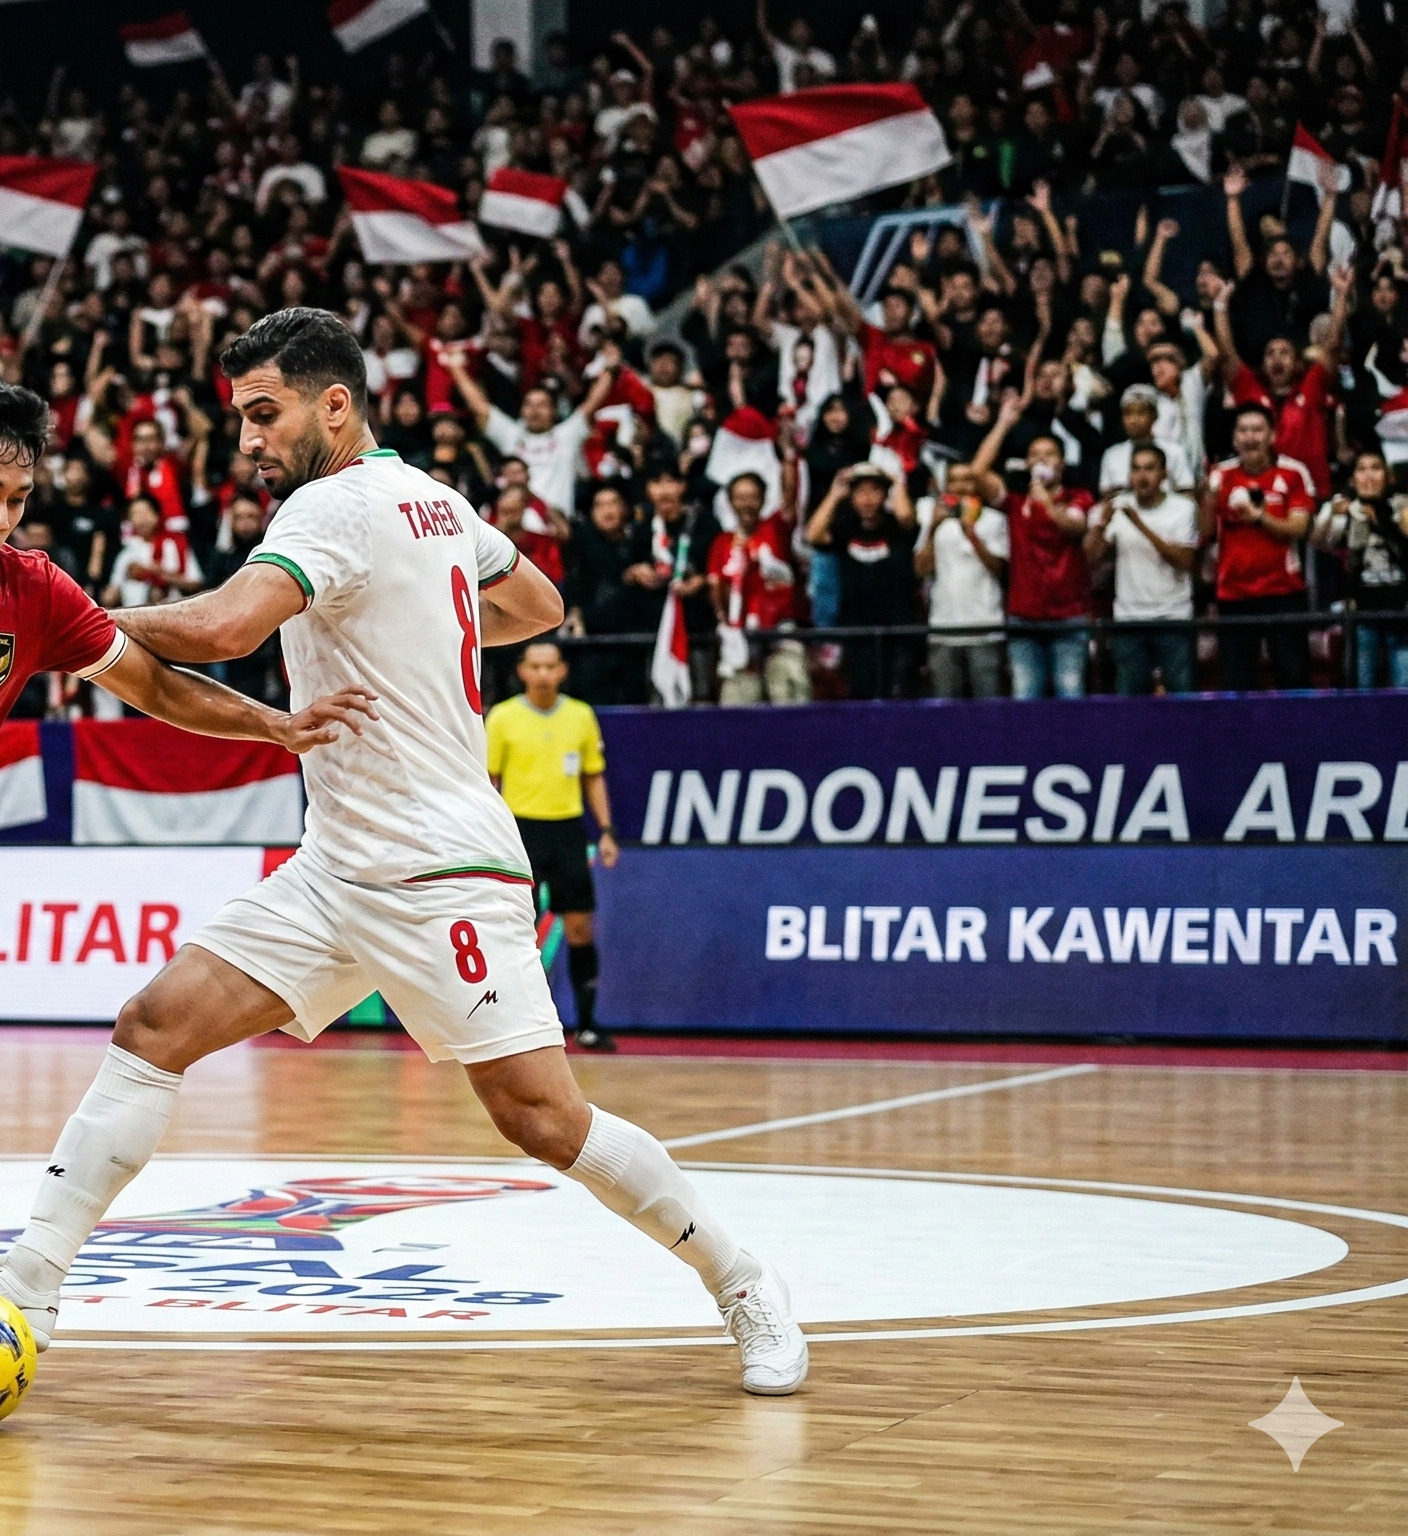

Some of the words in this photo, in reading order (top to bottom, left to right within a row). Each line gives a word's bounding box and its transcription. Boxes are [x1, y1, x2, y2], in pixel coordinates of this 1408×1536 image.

[451, 565, 482, 715] 8
[641, 764, 1190, 843] INDONESIA
[450, 920, 487, 984] 8
[765, 906, 988, 962] BLITAR
[1008, 907, 1399, 966] KAWENTAR
[85, 1231, 277, 1249] IFA
[144, 1298, 491, 1321] BLITAR
[149, 1278, 564, 1305] 2028
